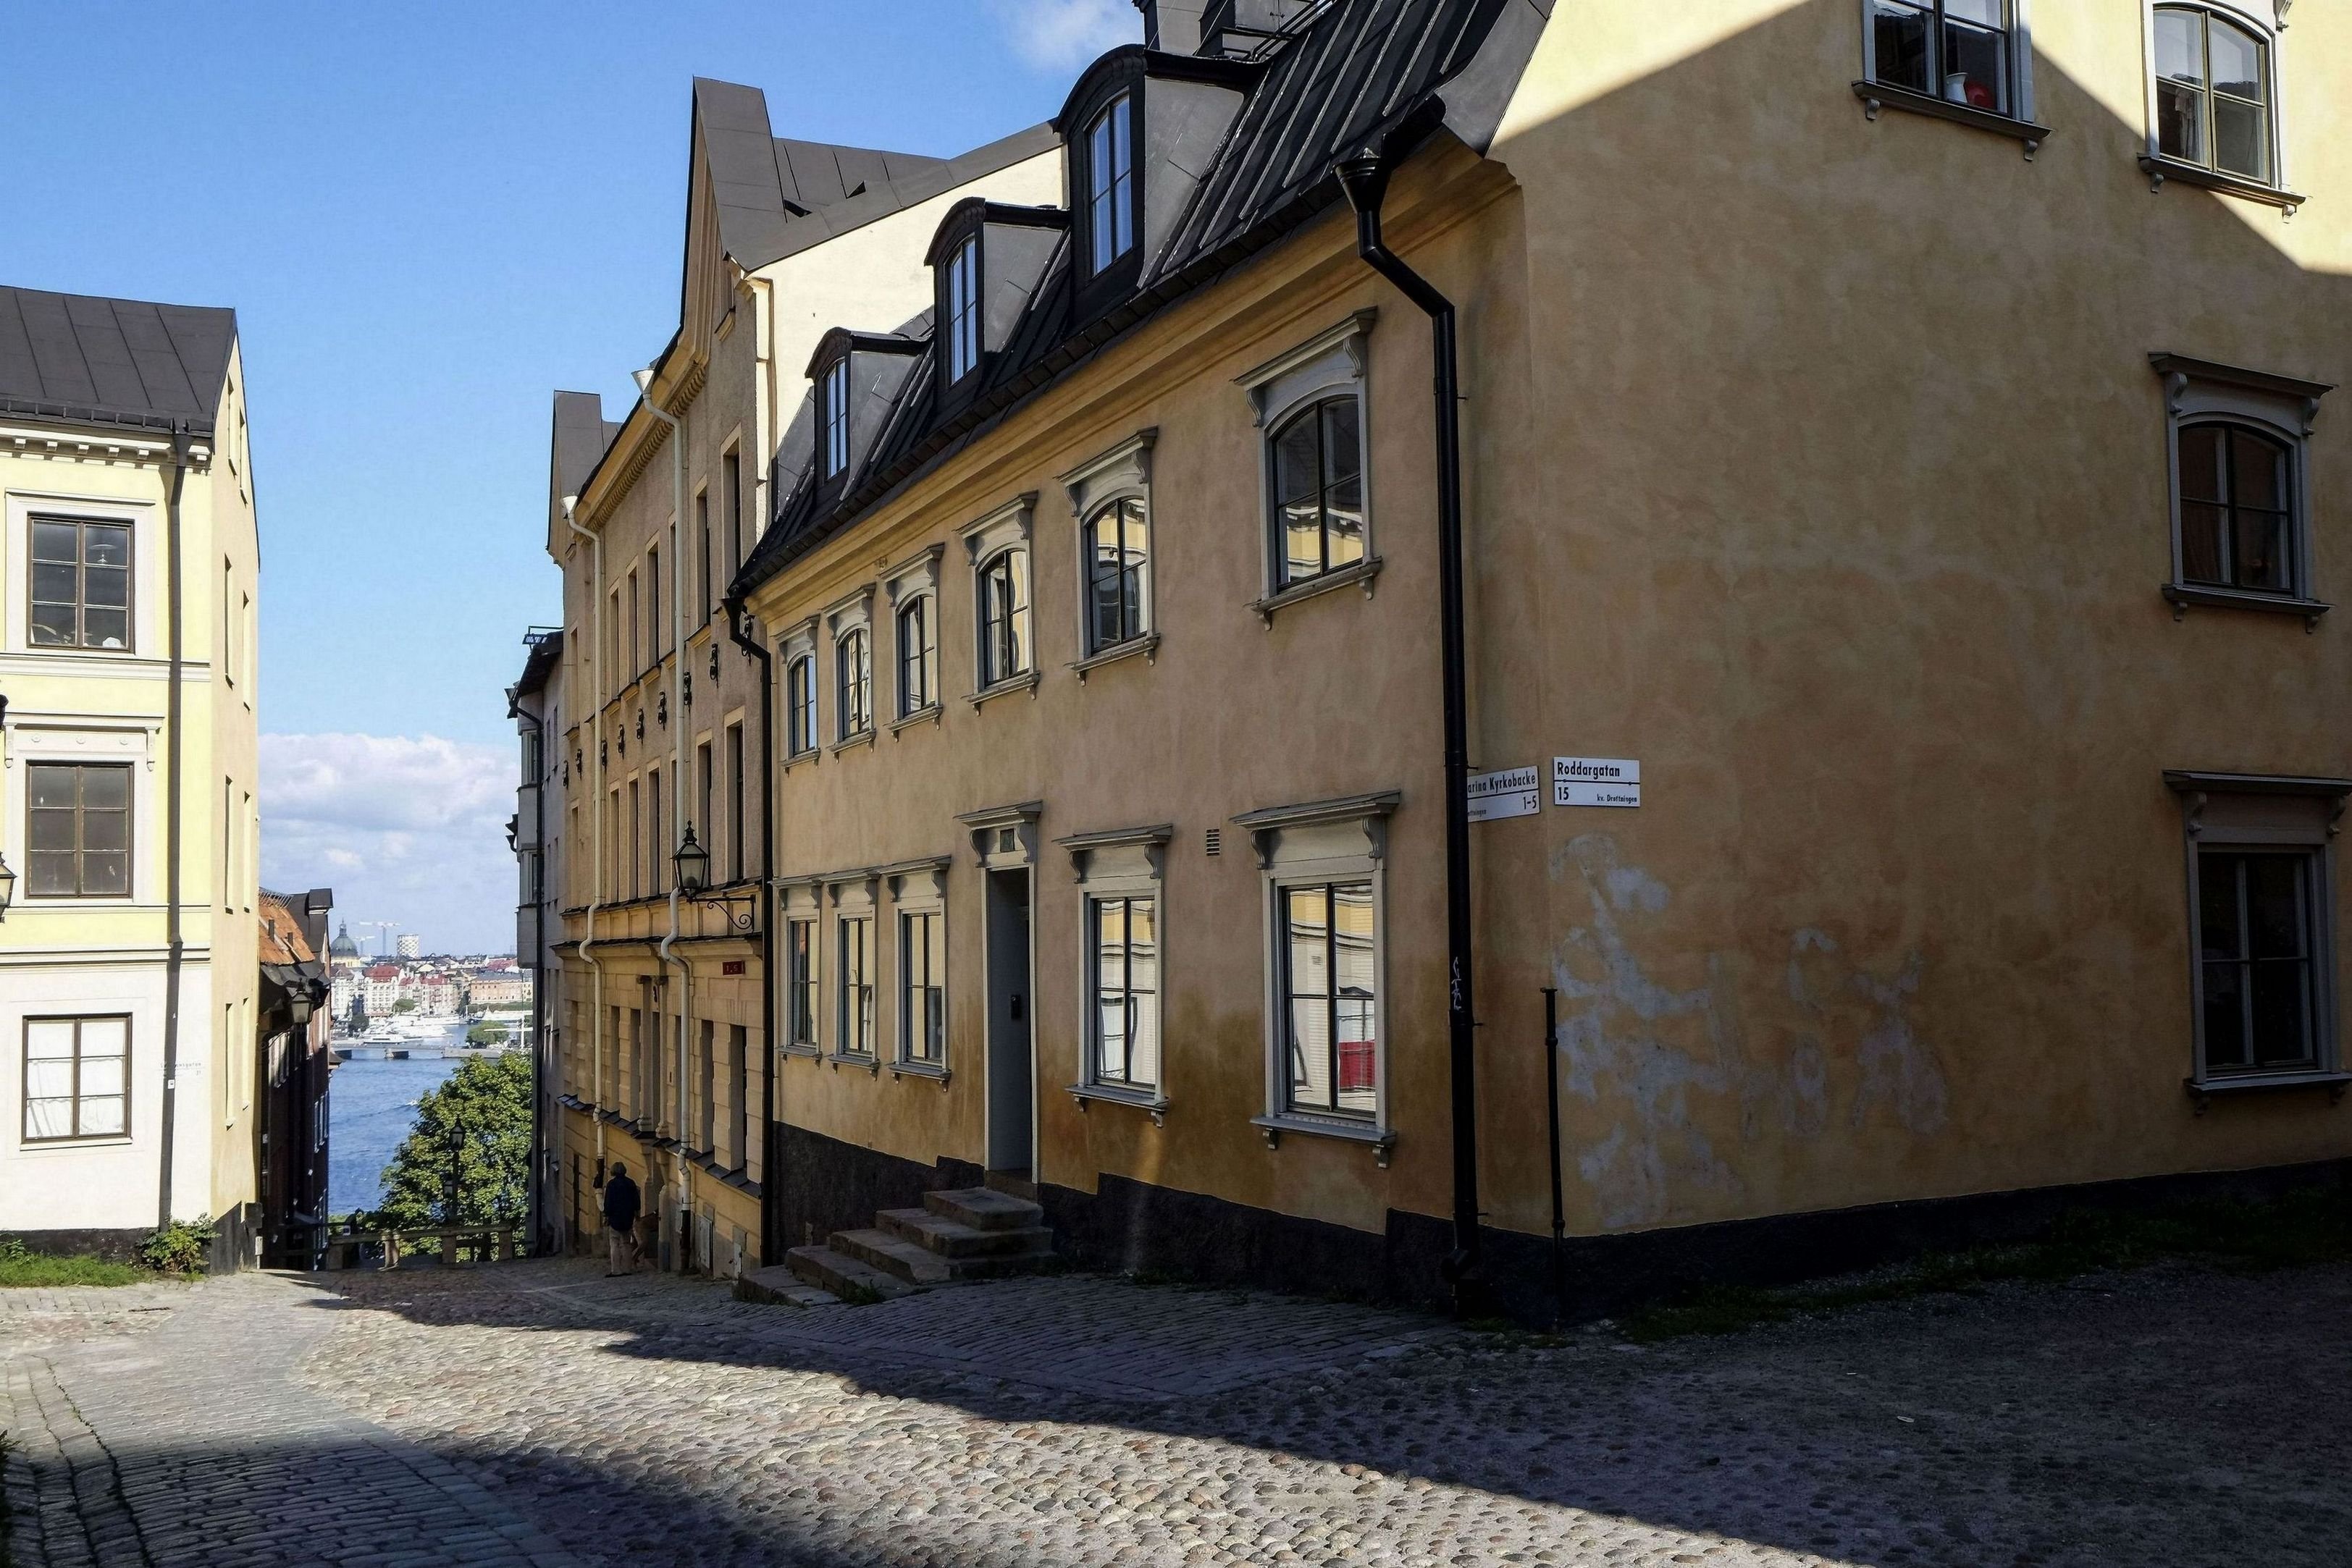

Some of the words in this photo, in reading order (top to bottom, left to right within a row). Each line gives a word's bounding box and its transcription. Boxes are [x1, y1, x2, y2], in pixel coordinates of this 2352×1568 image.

[1557, 760, 1620, 780] Roddargatan
[1468, 780, 1487, 793] arina
[1490, 770, 1536, 793] Kyrkobacke
[1558, 786, 1569, 801] 15
[1607, 794, 1637, 804] Drottningen
[1524, 795, 1537, 810] 1-5
